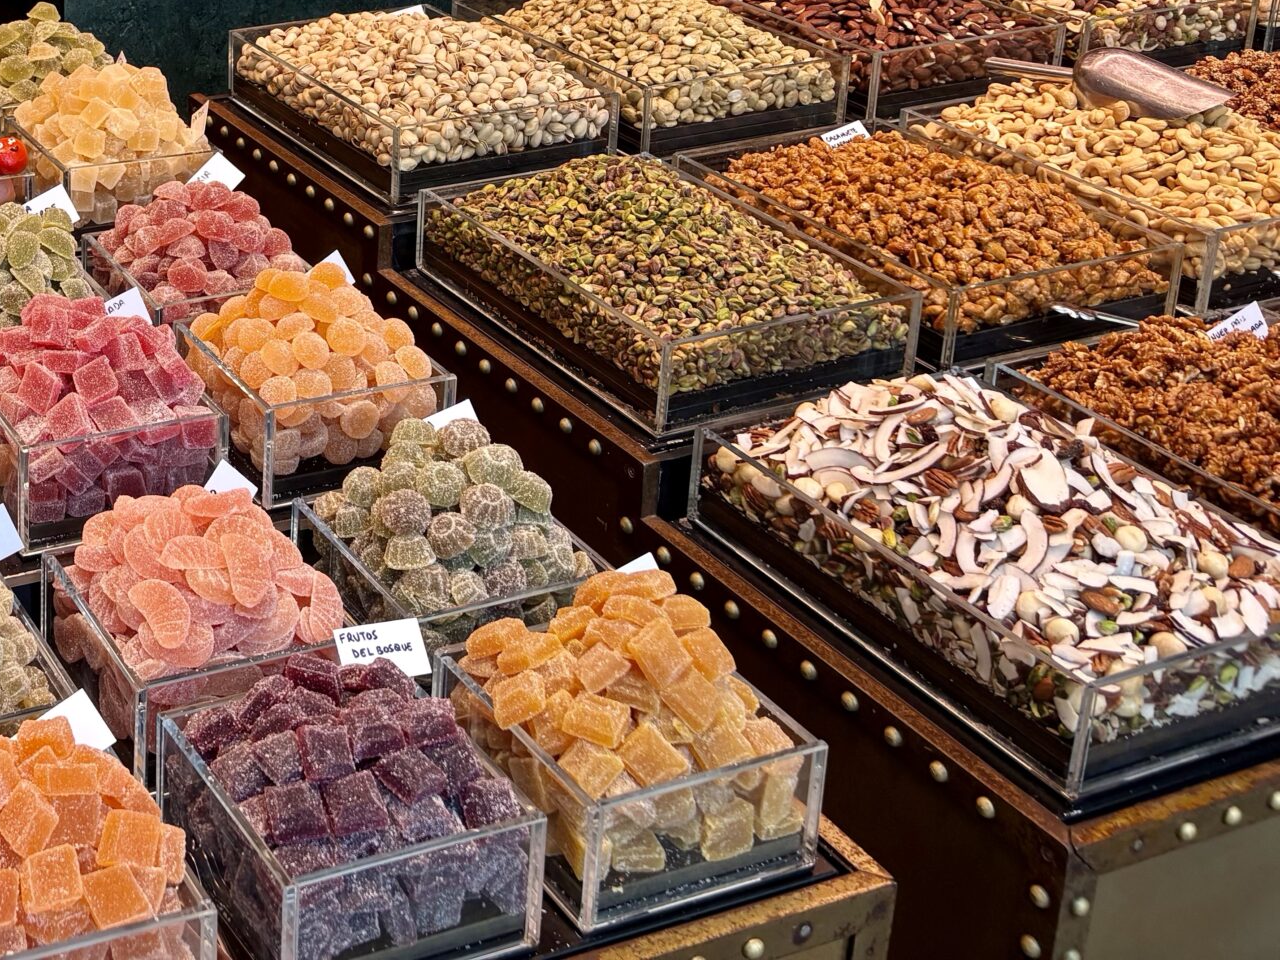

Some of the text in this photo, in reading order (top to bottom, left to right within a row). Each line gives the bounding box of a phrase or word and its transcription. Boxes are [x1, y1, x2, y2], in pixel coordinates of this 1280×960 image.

[339, 629, 378, 644] FRUTOS
[351, 642, 413, 658] DEL BOSQUE
